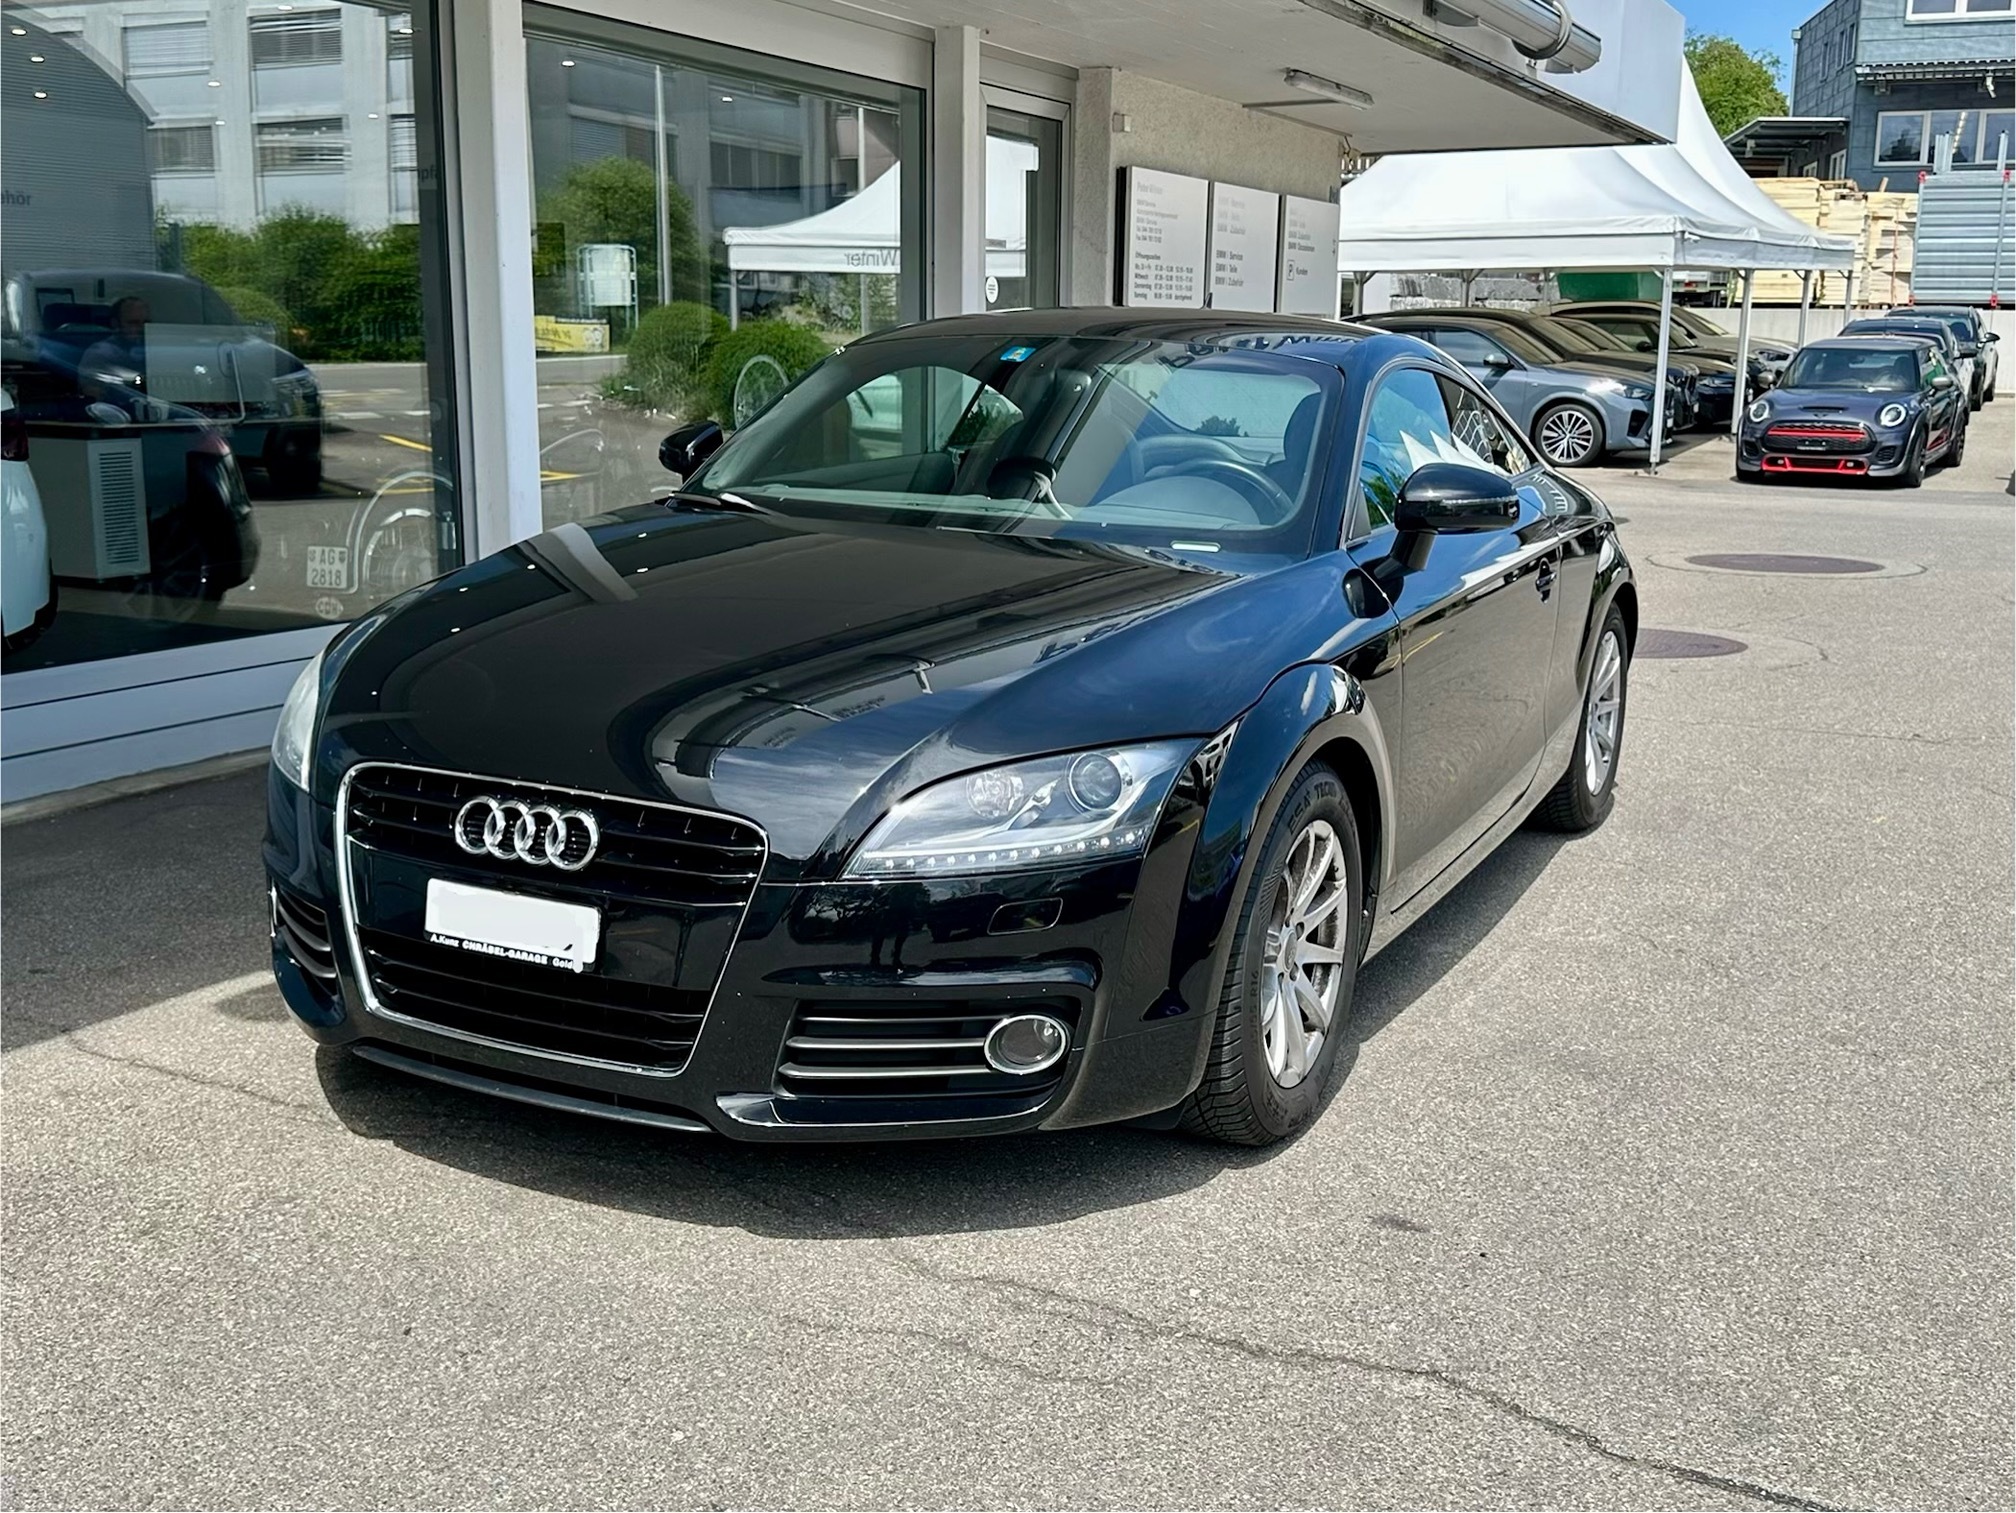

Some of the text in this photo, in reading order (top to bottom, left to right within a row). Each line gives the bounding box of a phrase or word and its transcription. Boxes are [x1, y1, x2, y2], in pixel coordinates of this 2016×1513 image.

[320, 548, 336, 565] AG
[311, 568, 342, 587] 2818
[430, 933, 460, 948] A.Kunz
[1249, 969, 1259, 998] R16
